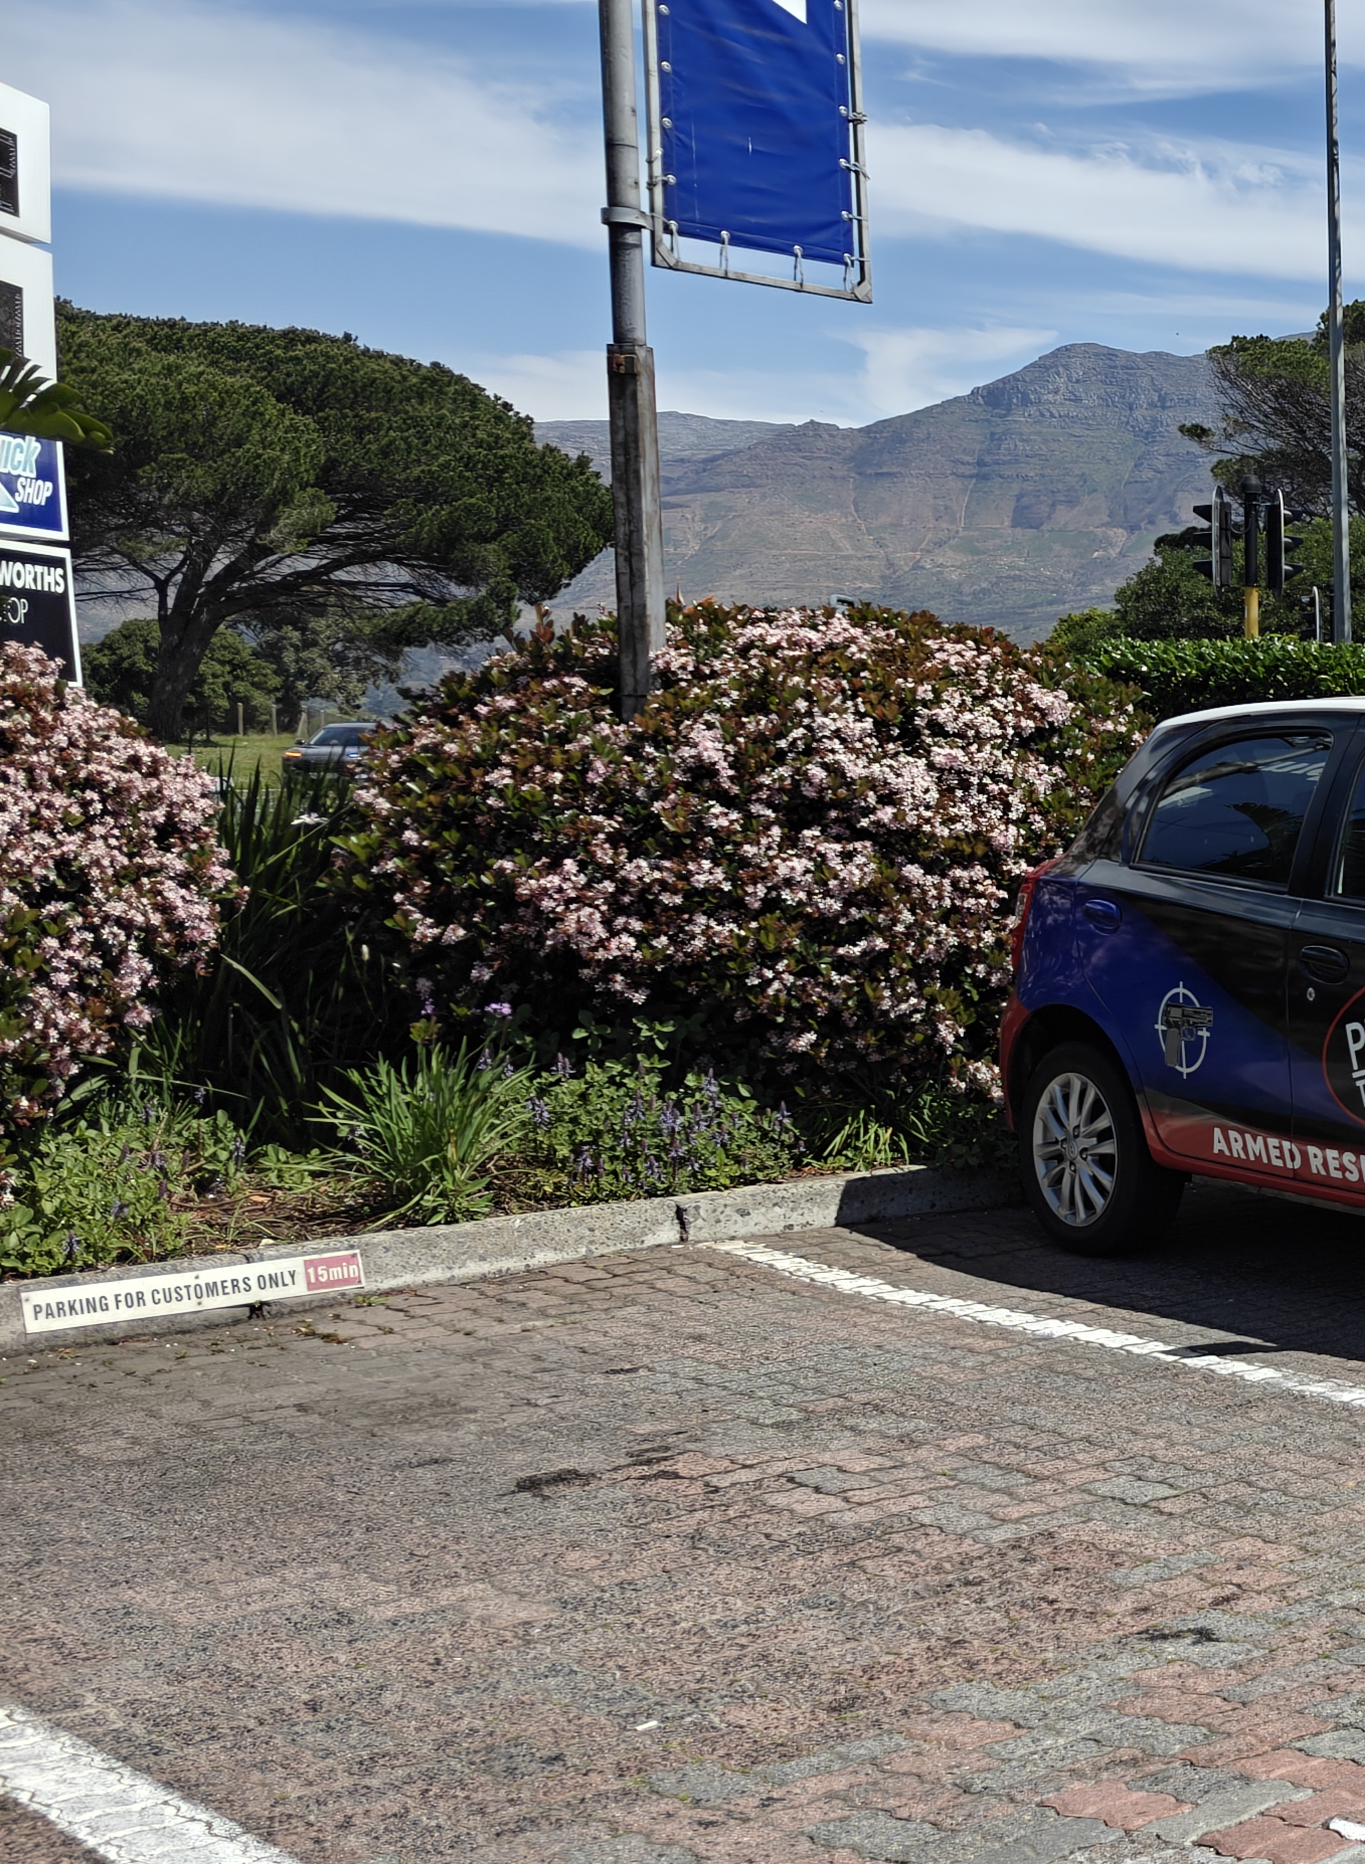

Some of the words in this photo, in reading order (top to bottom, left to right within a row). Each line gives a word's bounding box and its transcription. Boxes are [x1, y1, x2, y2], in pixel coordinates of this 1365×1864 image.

[15, 477, 53, 505] SHOP
[1213, 1127, 1301, 1170] ARMED
[33, 1294, 109, 1321] PARKING
[115, 1290, 146, 1310] FOR
[151, 1275, 252, 1305] CUSTOMERS
[257, 1269, 297, 1290] ONLY
[307, 1262, 358, 1284] 15min
